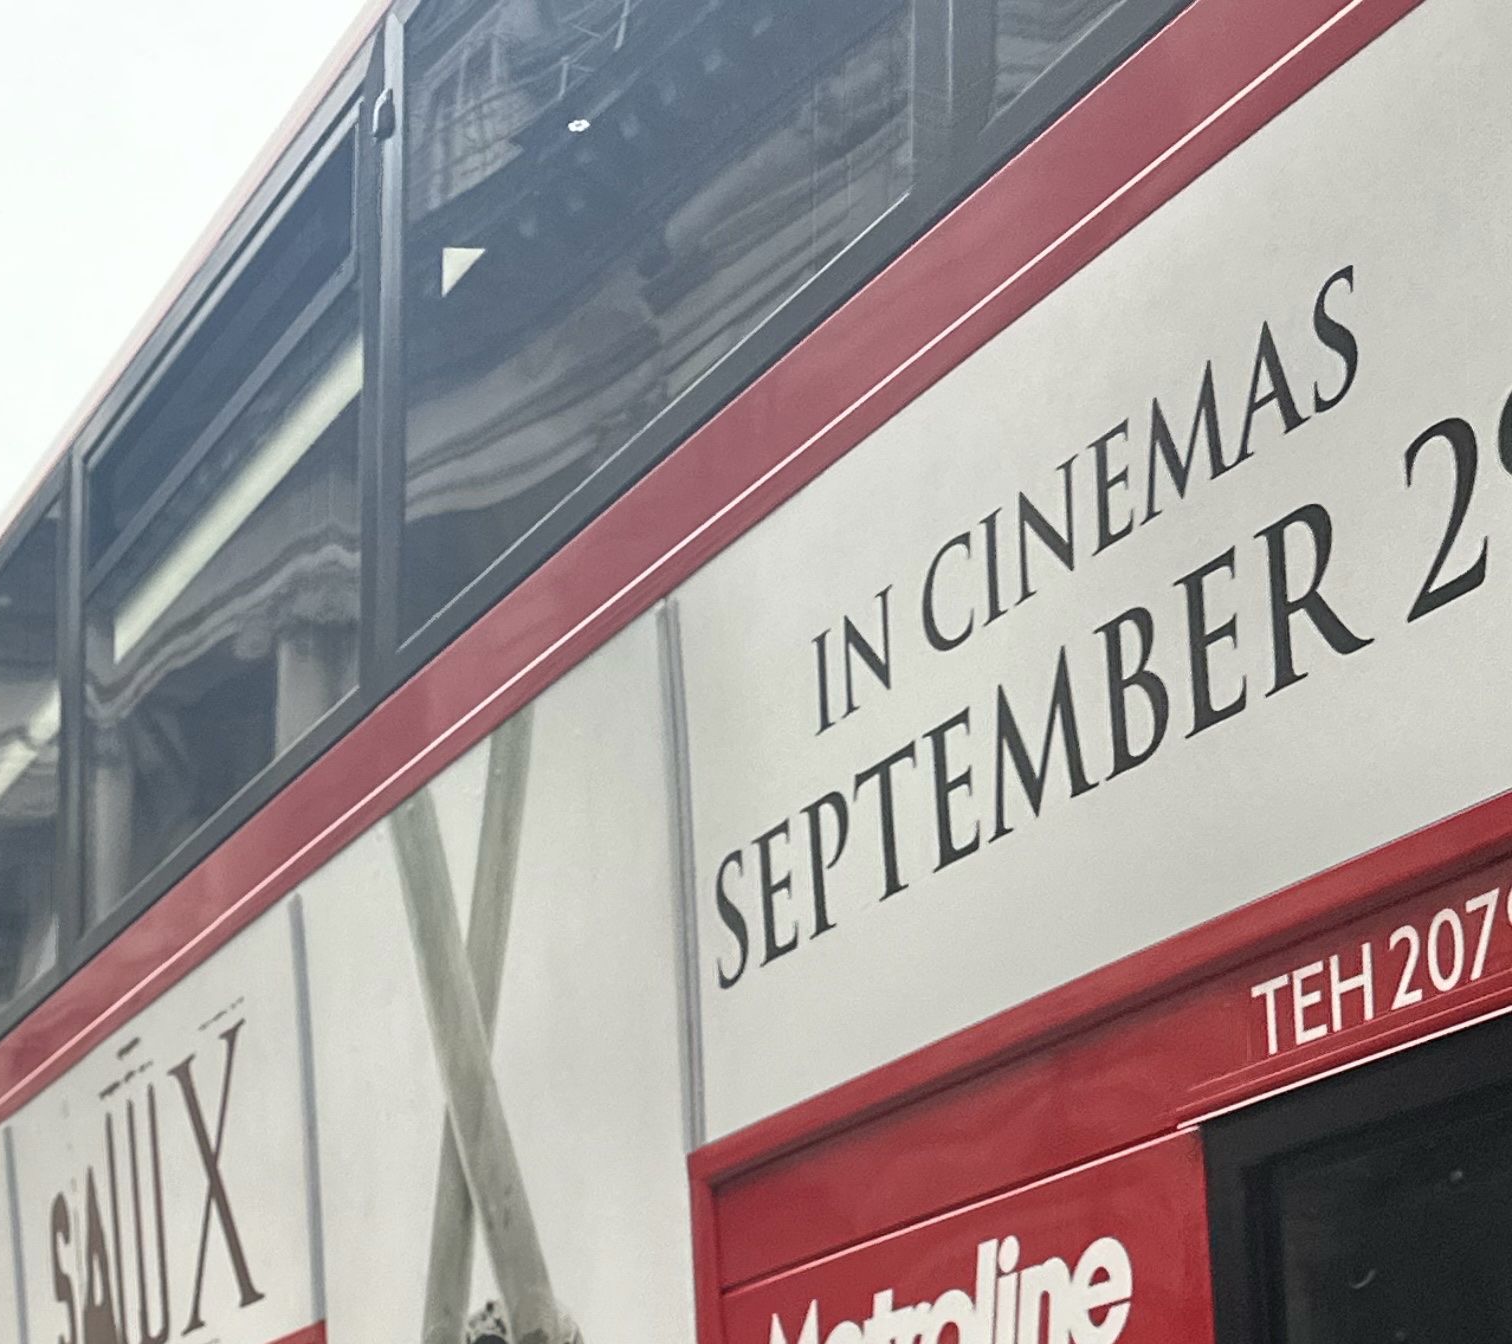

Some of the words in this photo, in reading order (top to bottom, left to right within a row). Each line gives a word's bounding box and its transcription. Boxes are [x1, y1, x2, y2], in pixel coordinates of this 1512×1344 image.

[715, 502, 1375, 991] SEPTEMBER
[1403, 386, 1512, 624] 2
[811, 584, 893, 736] IN
[921, 264, 1360, 653] CINEMAS
[1250, 941, 1375, 1056] TEH
[1388, 883, 1512, 1011] 207
[167, 1017, 266, 1336] X
